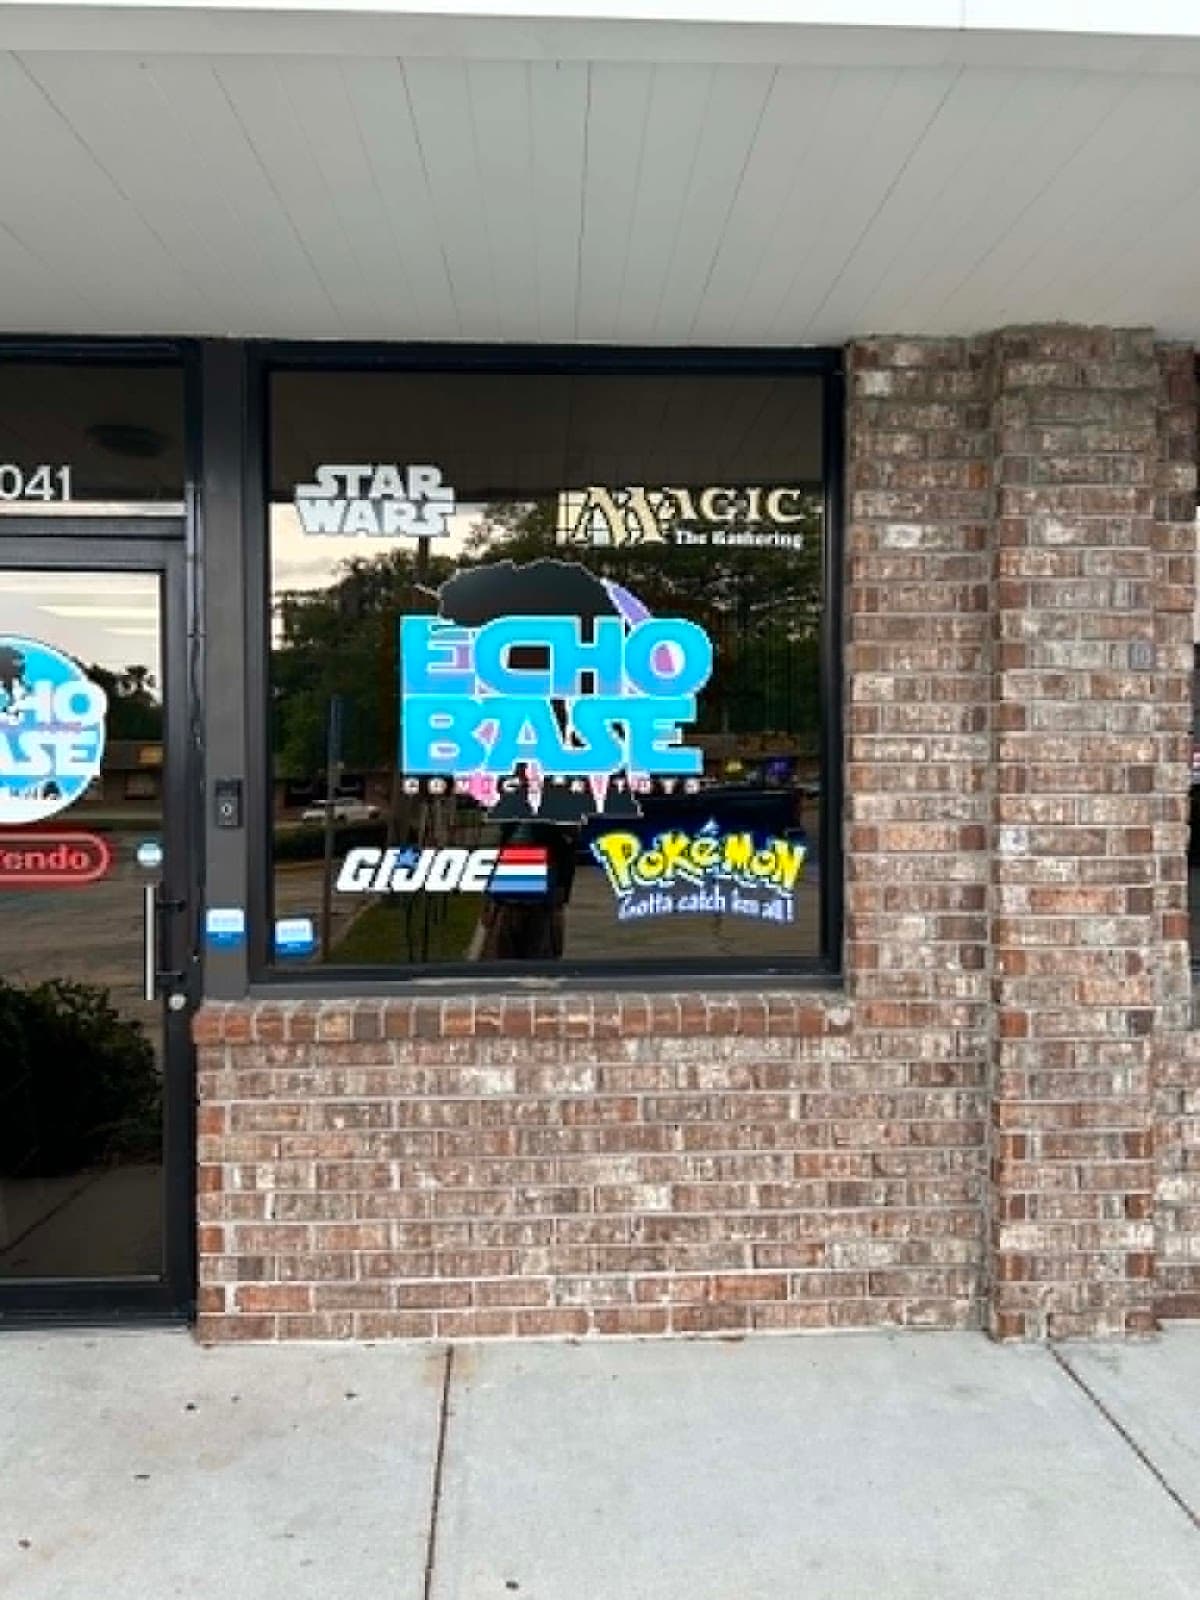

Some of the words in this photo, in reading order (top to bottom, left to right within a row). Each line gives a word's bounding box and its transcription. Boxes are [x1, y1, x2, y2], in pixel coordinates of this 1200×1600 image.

[0, 464, 70, 500] 041
[296, 464, 454, 500] STAR
[297, 499, 455, 536] WARS
[399, 615, 712, 697] ECHO
[402, 695, 704, 774] BASE
[678, 883, 726, 912] catch
